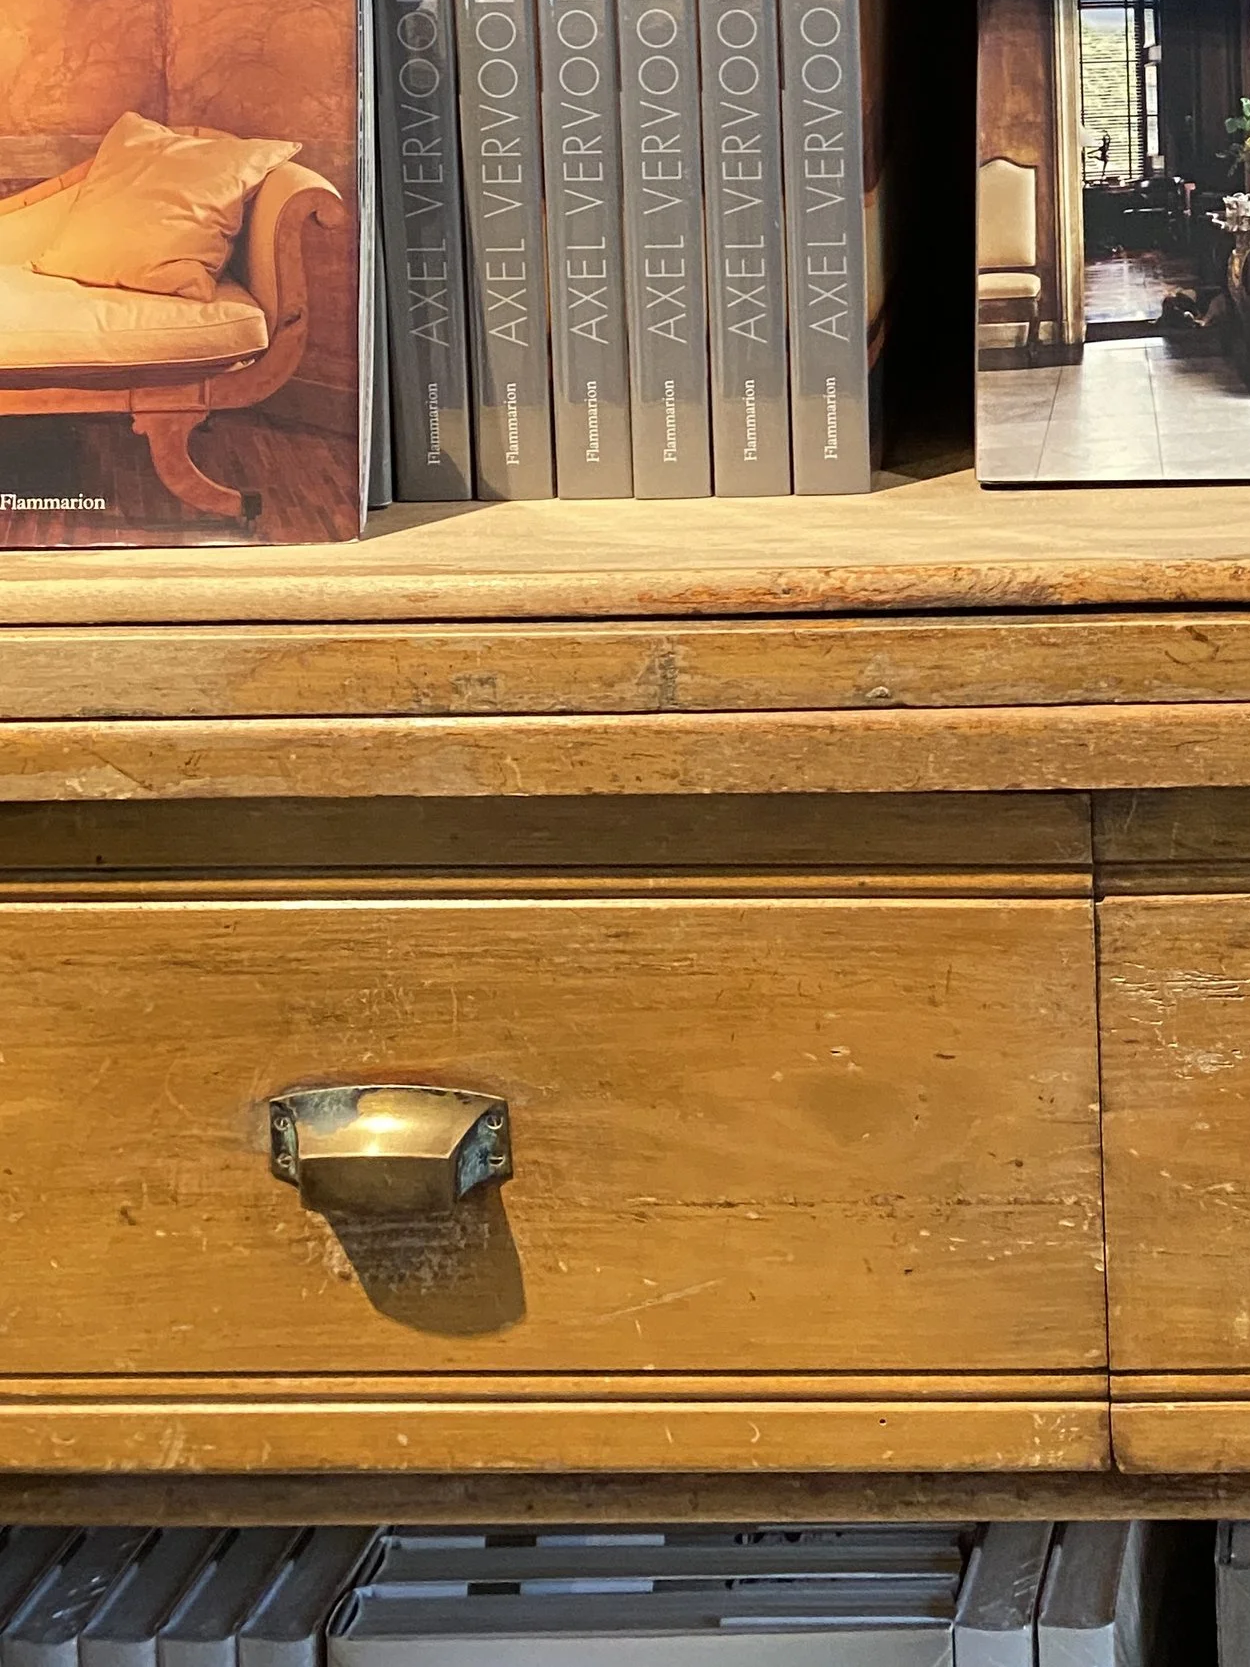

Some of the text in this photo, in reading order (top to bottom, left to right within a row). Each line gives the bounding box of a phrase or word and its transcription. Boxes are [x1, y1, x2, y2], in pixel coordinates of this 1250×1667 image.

[406, 238, 451, 348] AXEL
[485, 237, 529, 347] AXEL
[566, 236, 609, 346] AXEL
[643, 234, 688, 345] AXEL
[724, 234, 768, 345] AXEL
[806, 233, 850, 344] AXEL
[427, 381, 442, 467] Flammarion
[505, 382, 521, 466] Flammarion
[585, 380, 601, 464] Flammarion
[662, 379, 678, 463] Flammarion
[743, 378, 758, 462] Flammarion
[823, 376, 838, 460] Flammarion
[0, 493, 106, 511] Flammarion
